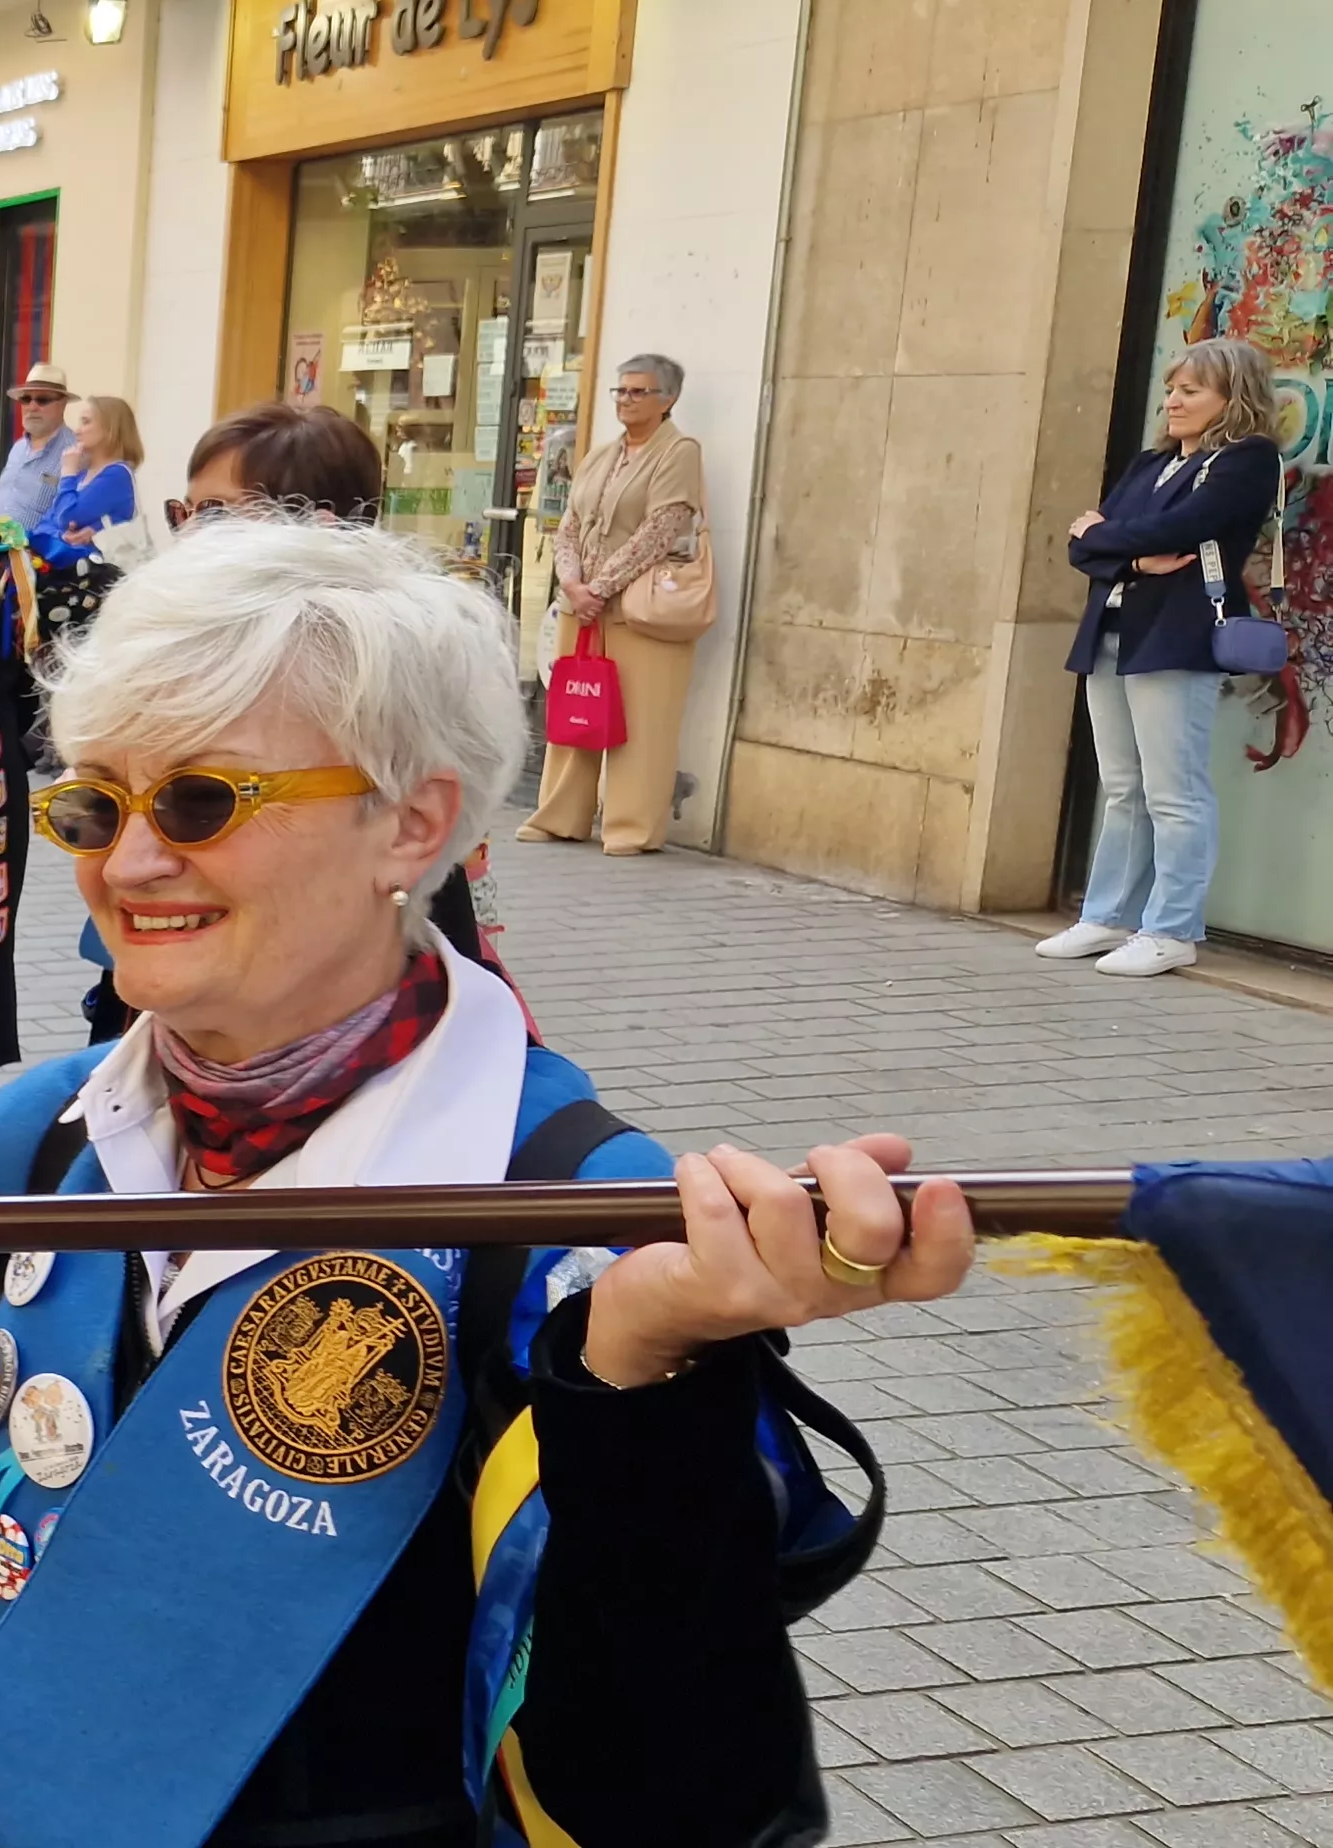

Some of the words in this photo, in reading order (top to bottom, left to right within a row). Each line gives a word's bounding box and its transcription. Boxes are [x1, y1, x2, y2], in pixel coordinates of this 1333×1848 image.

[274, 0, 379, 86] Fleur
[392, 0, 446, 56] de
[230, 1258, 393, 1374] CAESARAVGVSTANAE
[401, 1291, 443, 1387] STVDIVM
[179, 1400, 337, 1537] ZARAGOZA
[233, 1393, 307, 1470] CIVITATIS
[326, 1409, 428, 1474] GENERALE
